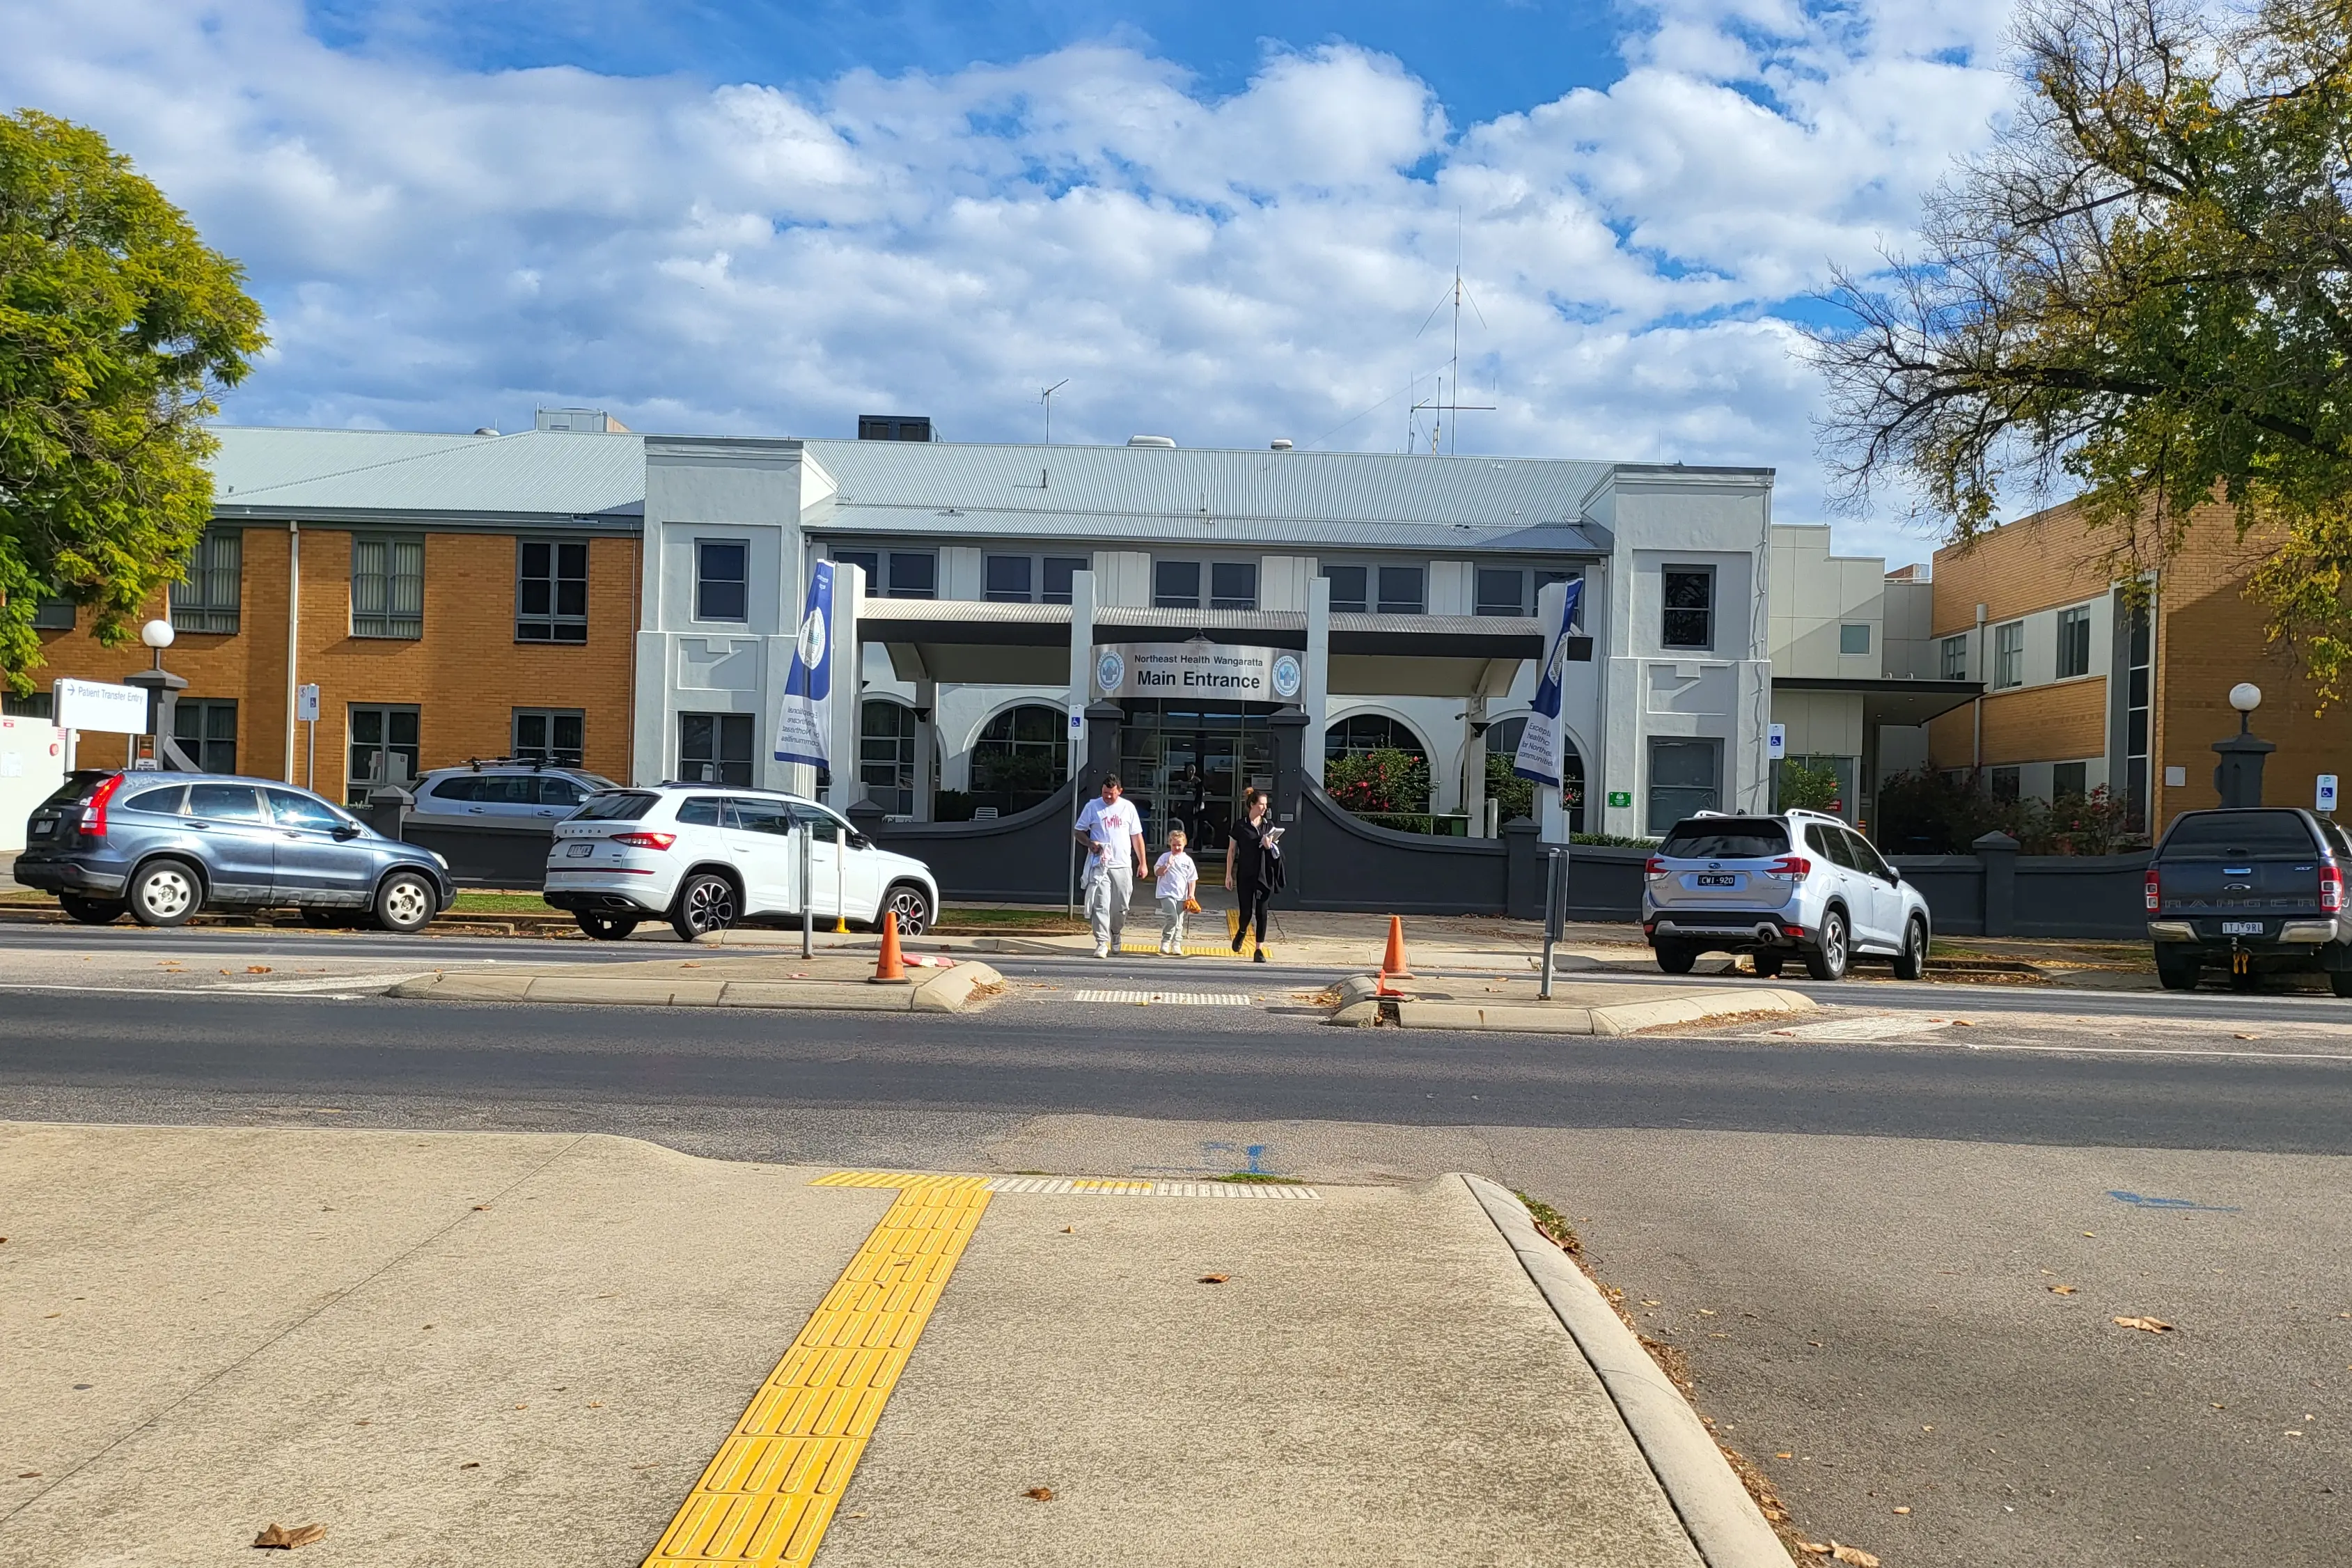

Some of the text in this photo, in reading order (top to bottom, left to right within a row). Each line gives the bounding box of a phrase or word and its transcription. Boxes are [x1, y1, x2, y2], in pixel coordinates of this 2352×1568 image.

[1134, 654, 1177, 664] Northeast
[1180, 654, 1210, 664] Health
[1213, 656, 1263, 667] Wangaratta
[1137, 671, 1176, 686] Main
[1184, 671, 1260, 689] Entrance
[78, 686, 143, 705] Patient Transfer Entry
[1101, 813, 1122, 829] Thrills
[2165, 898, 2316, 909] RANGER
